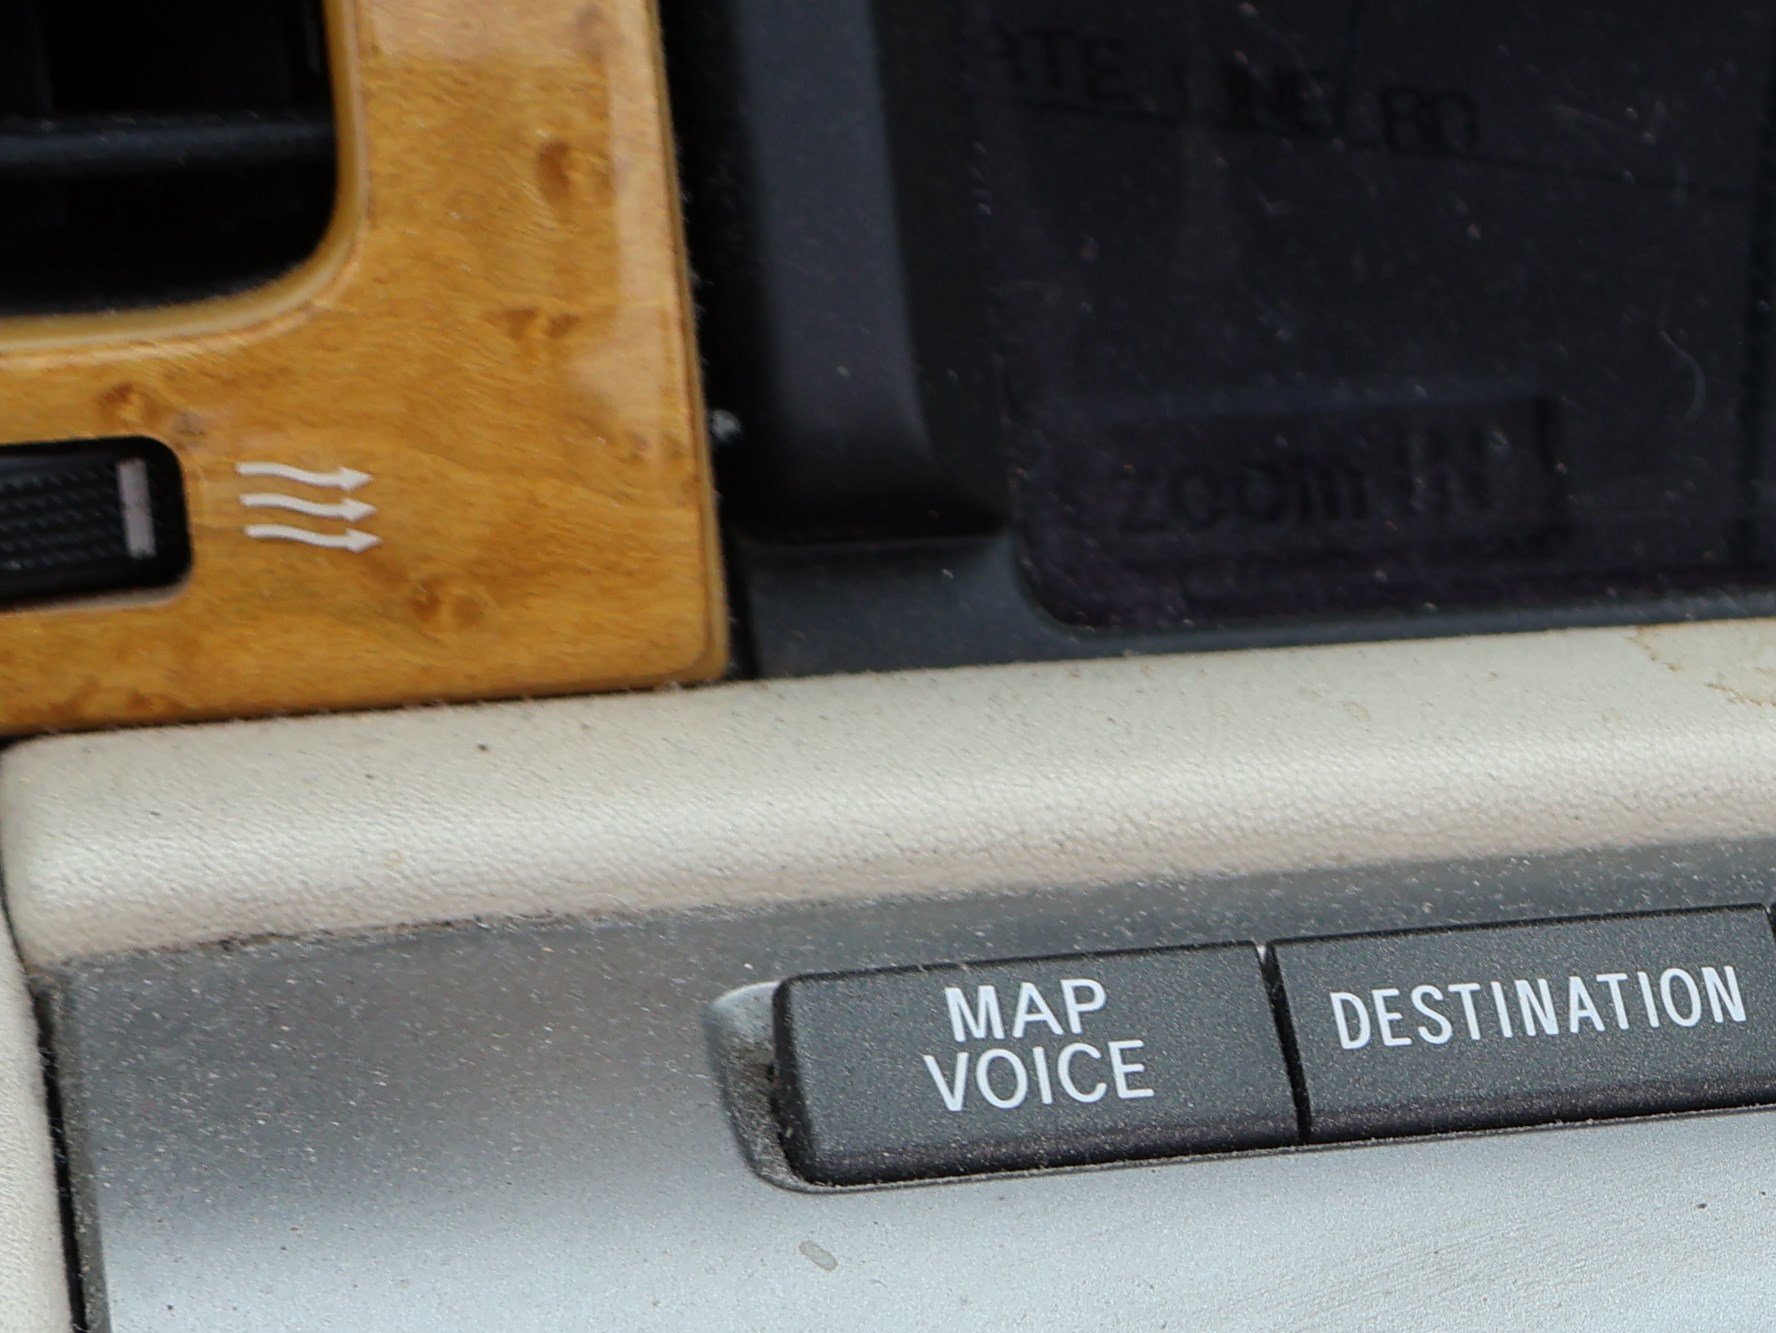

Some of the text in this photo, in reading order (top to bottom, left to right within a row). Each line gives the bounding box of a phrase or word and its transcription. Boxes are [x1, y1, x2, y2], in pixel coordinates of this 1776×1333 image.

[944, 976, 1108, 1044] MAP
[1328, 964, 1747, 1051] DESTINATION
[922, 1038, 1156, 1112] VOICE
